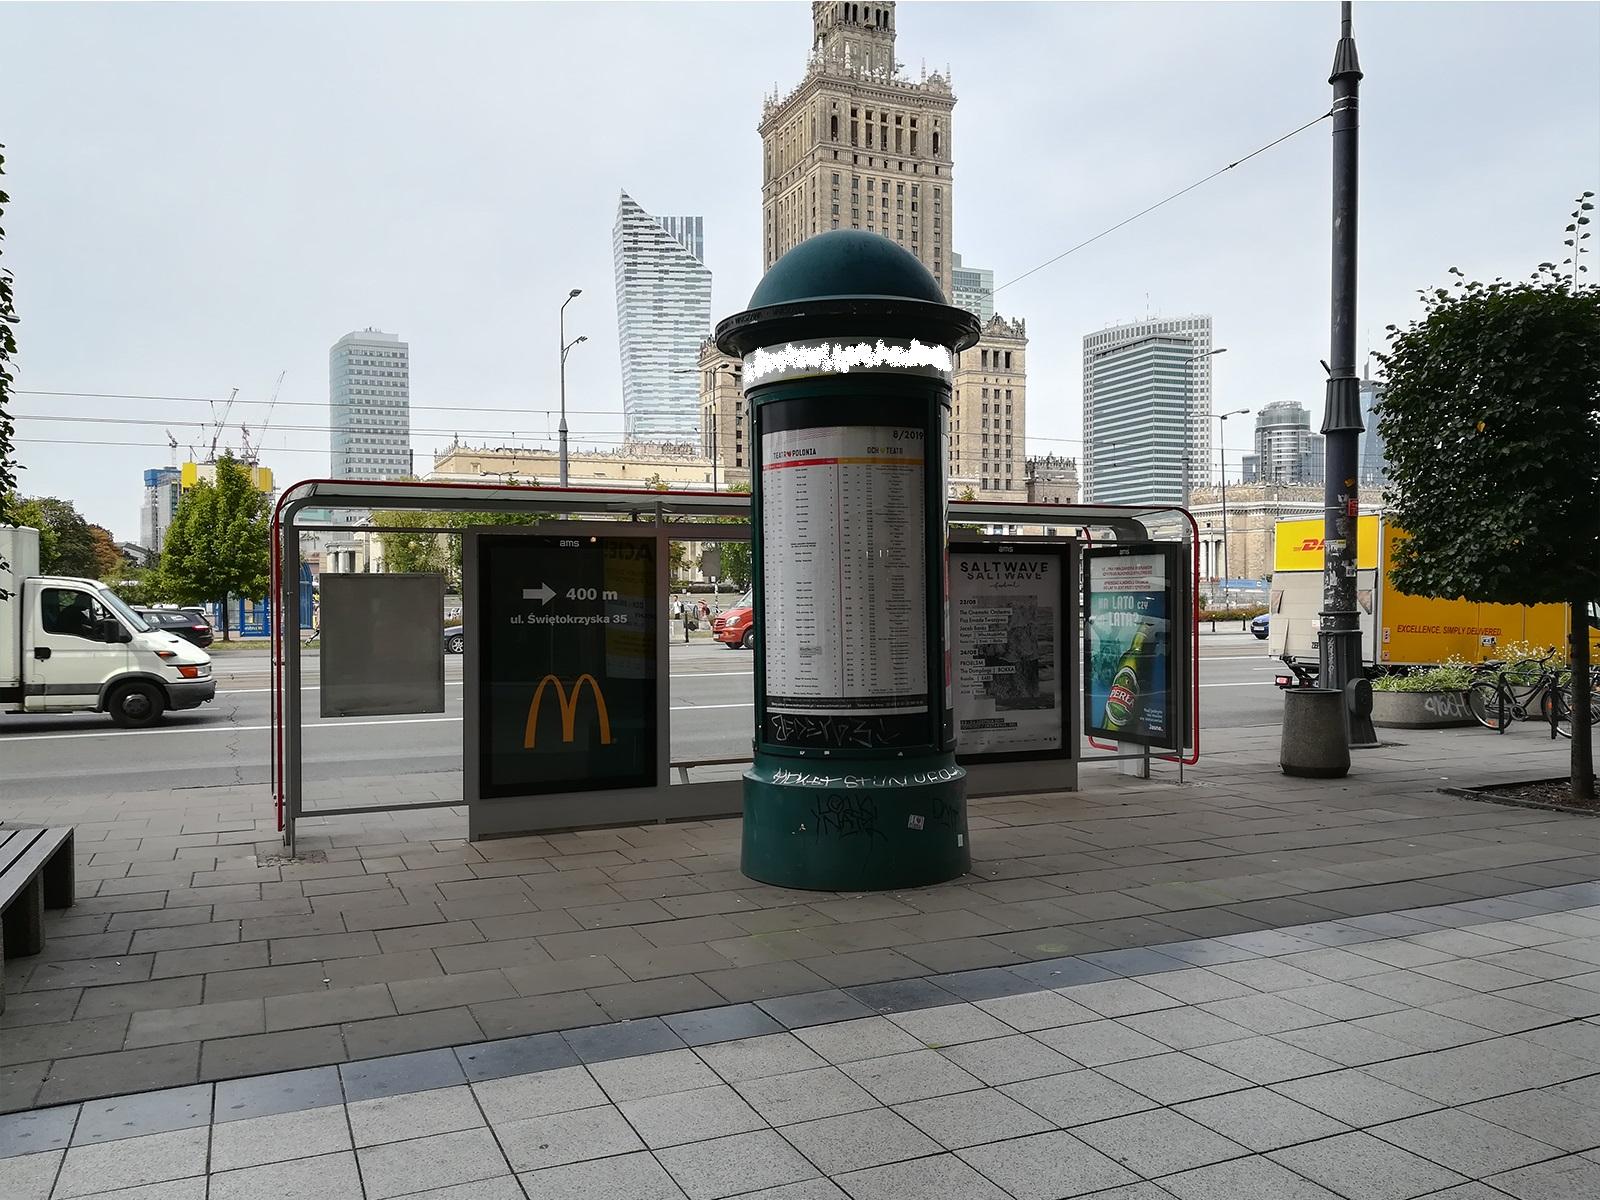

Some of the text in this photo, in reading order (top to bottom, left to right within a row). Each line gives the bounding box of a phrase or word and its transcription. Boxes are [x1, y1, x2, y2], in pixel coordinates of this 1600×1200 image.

[893, 430, 924, 440] 8/2019
[559, 539, 580, 548] ams
[960, 561, 1049, 573] SALTWAVE
[566, 588, 618, 601] 400 m
[510, 613, 628, 626] ul. Świętokrzyska 35
[1443, 625, 1466, 635] SIMPLY
